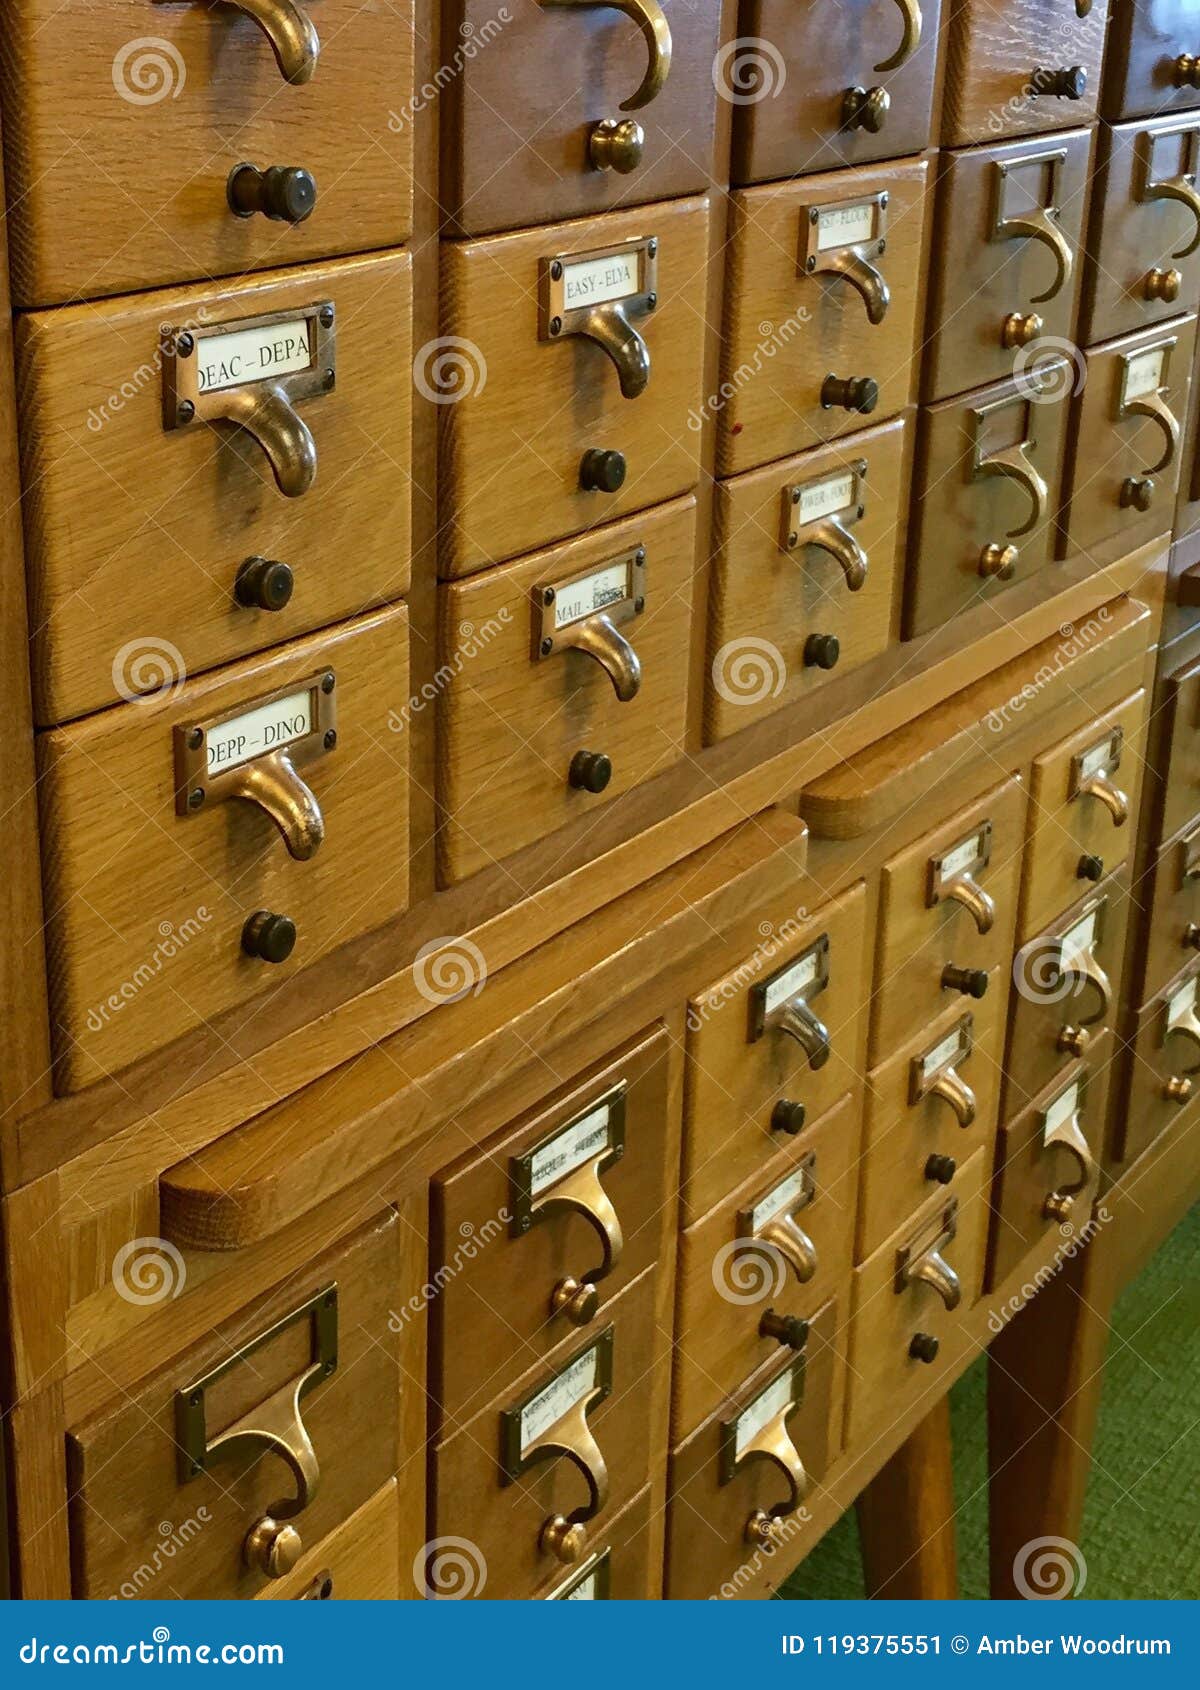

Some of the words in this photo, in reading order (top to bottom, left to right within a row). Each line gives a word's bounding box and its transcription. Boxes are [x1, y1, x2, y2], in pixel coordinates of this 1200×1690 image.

[567, 275, 595, 299] EASY
[605, 265, 631, 287] ELYA
[259, 336, 309, 367] DEPA
[557, 601, 583, 622] MAIL
[264, 714, 306, 746] DINO
